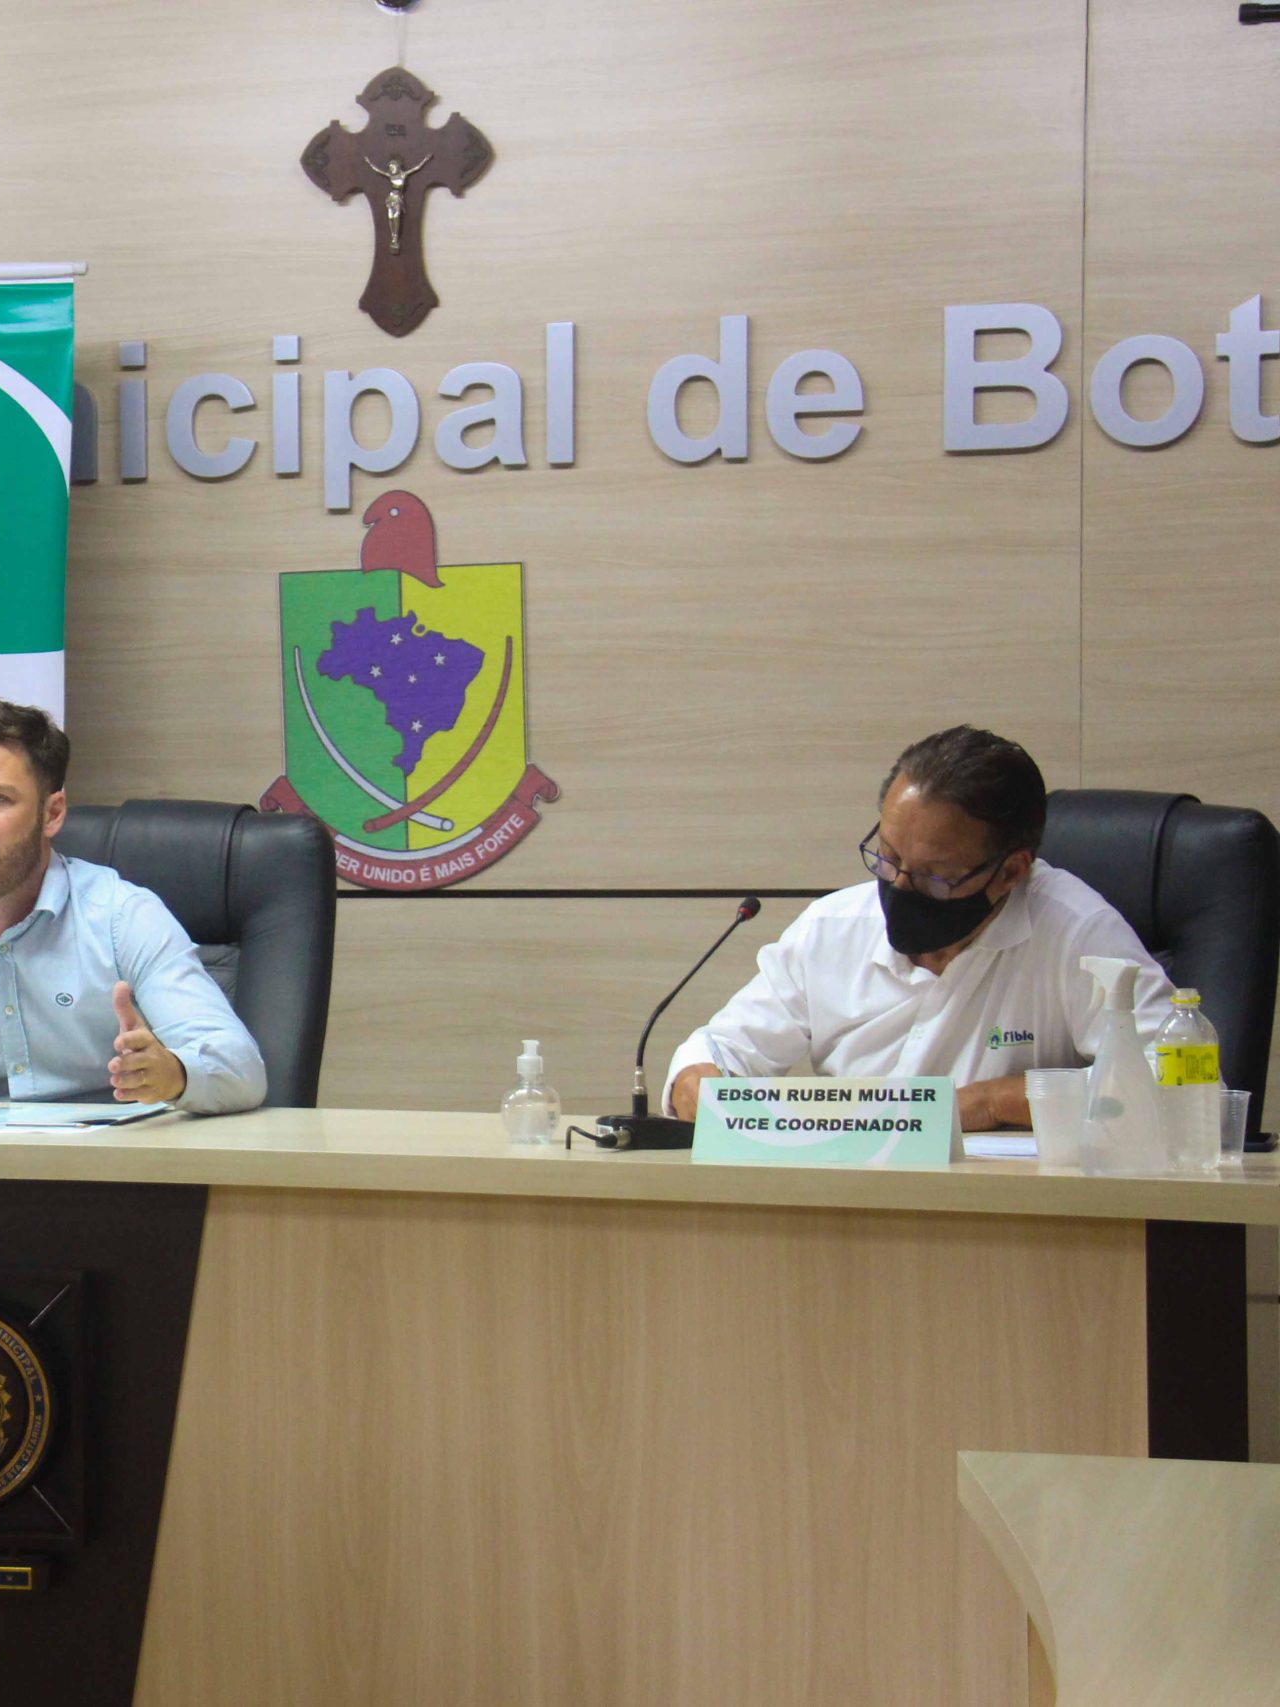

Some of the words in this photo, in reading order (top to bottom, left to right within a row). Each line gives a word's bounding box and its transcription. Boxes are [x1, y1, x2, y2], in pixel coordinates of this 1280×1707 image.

[647, 314, 865, 464] de
[944, 293, 1280, 457] Bot
[362, 866, 416, 884] UNIDO
[420, 865, 431, 882] É
[434, 852, 476, 880] MAIS
[475, 813, 525, 860] FORTE
[717, 1088, 781, 1101] EDSON
[786, 1088, 853, 1101] RUBEN
[858, 1088, 937, 1102] MULLER
[725, 1117, 769, 1130] VICE
[775, 1118, 923, 1132] COORDENADOR
